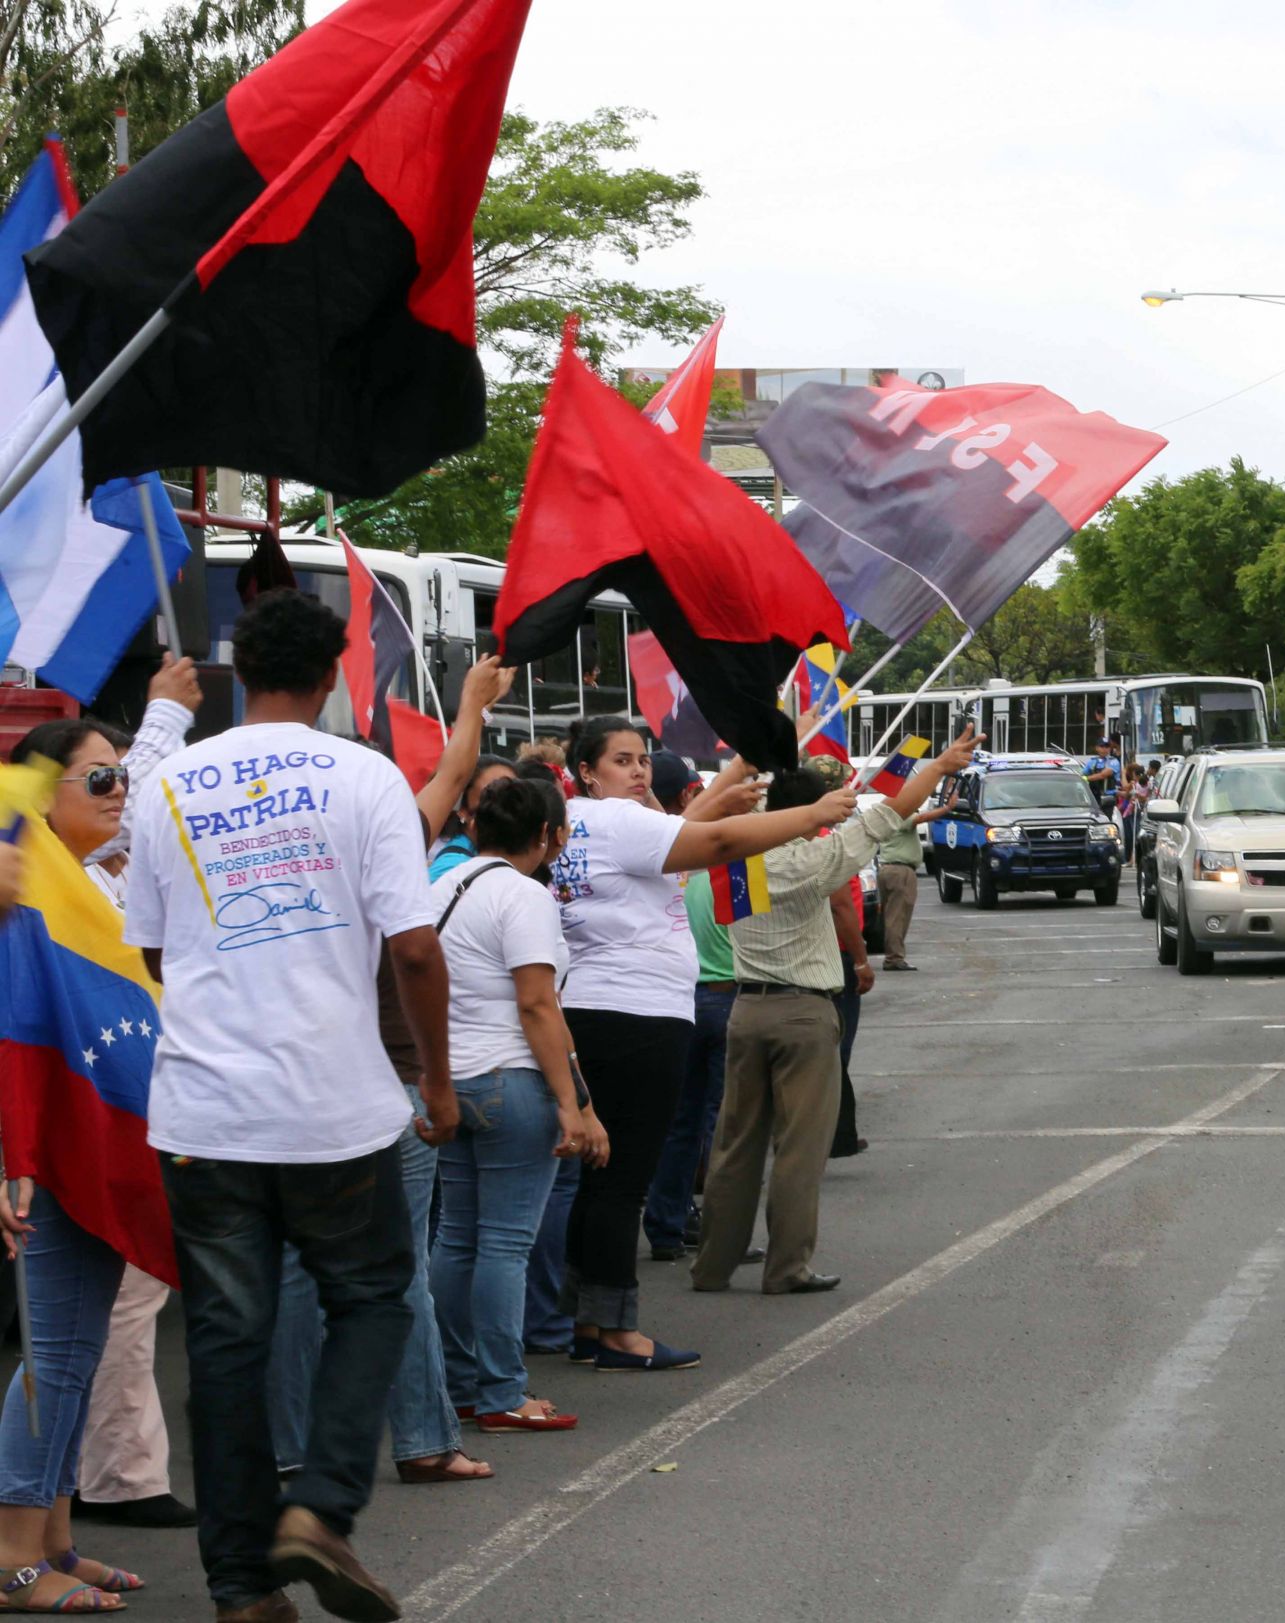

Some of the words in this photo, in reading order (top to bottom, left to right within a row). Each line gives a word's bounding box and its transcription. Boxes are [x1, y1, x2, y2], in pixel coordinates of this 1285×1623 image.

[1151, 731, 1165, 744] 112
[177, 765, 221, 794] YO
[232, 751, 336, 785] HAGO
[185, 786, 329, 841] PATRIA!
[219, 827, 317, 855] BENDECIDOS,
[570, 848, 587, 859] EN
[206, 844, 310, 876] PROSPERADOS
[316, 842, 326, 855] Y
[226, 873, 247, 887] EN
[253, 857, 342, 881] VICTORIAS!
